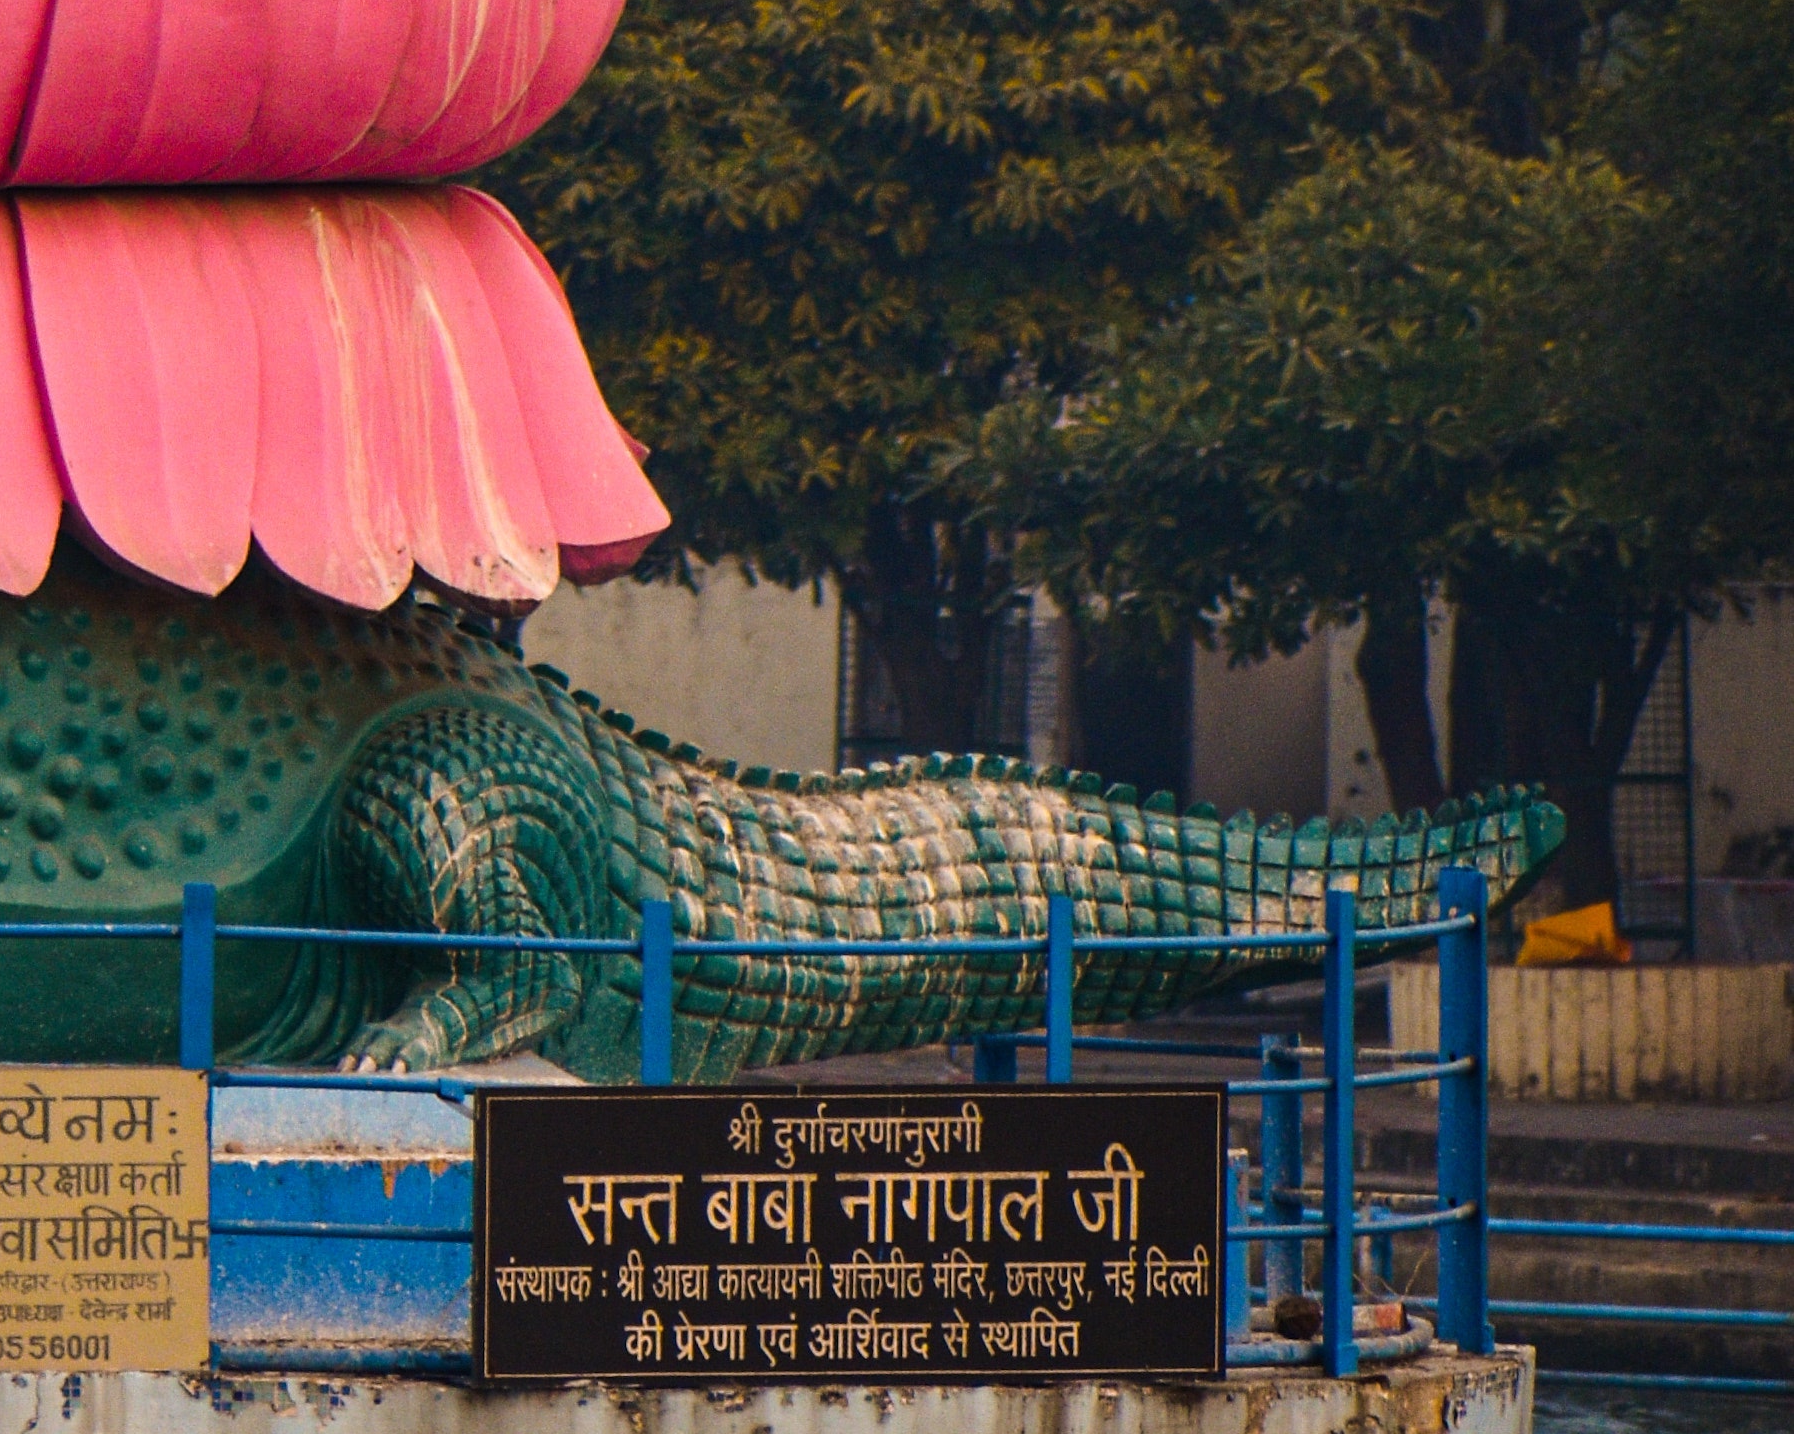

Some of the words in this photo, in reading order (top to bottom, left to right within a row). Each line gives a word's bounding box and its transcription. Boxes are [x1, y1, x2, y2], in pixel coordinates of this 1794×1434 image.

[727, 1101, 762, 1154] श्री
[119, 1150, 187, 1196] कर्ता
[563, 1174, 684, 1245] सन्त
[701, 1173, 818, 1244] बाबा
[835, 1171, 1050, 1243] नागपाल
[1067, 1142, 1145, 1242] जी
[43, 1204, 173, 1261] समिति
[495, 1256, 593, 1302] संस्थापक
[616, 1249, 644, 1302] श्री
[653, 1264, 709, 1301] आद्या
[717, 1247, 823, 1301] कात्यायनी
[830, 1246, 924, 1300] शक्तिपीठ
[932, 1247, 995, 1303] मंदिर,
[1103, 1246, 1137, 1304] नई
[1145, 1244, 1210, 1297] दिल्ली
[624, 1309, 664, 1362] की
[673, 1311, 748, 1361] प्रेरणा
[756, 1313, 798, 1368] एवं
[941, 1308, 970, 1359] से
[979, 1306, 1081, 1358] स्थापित
